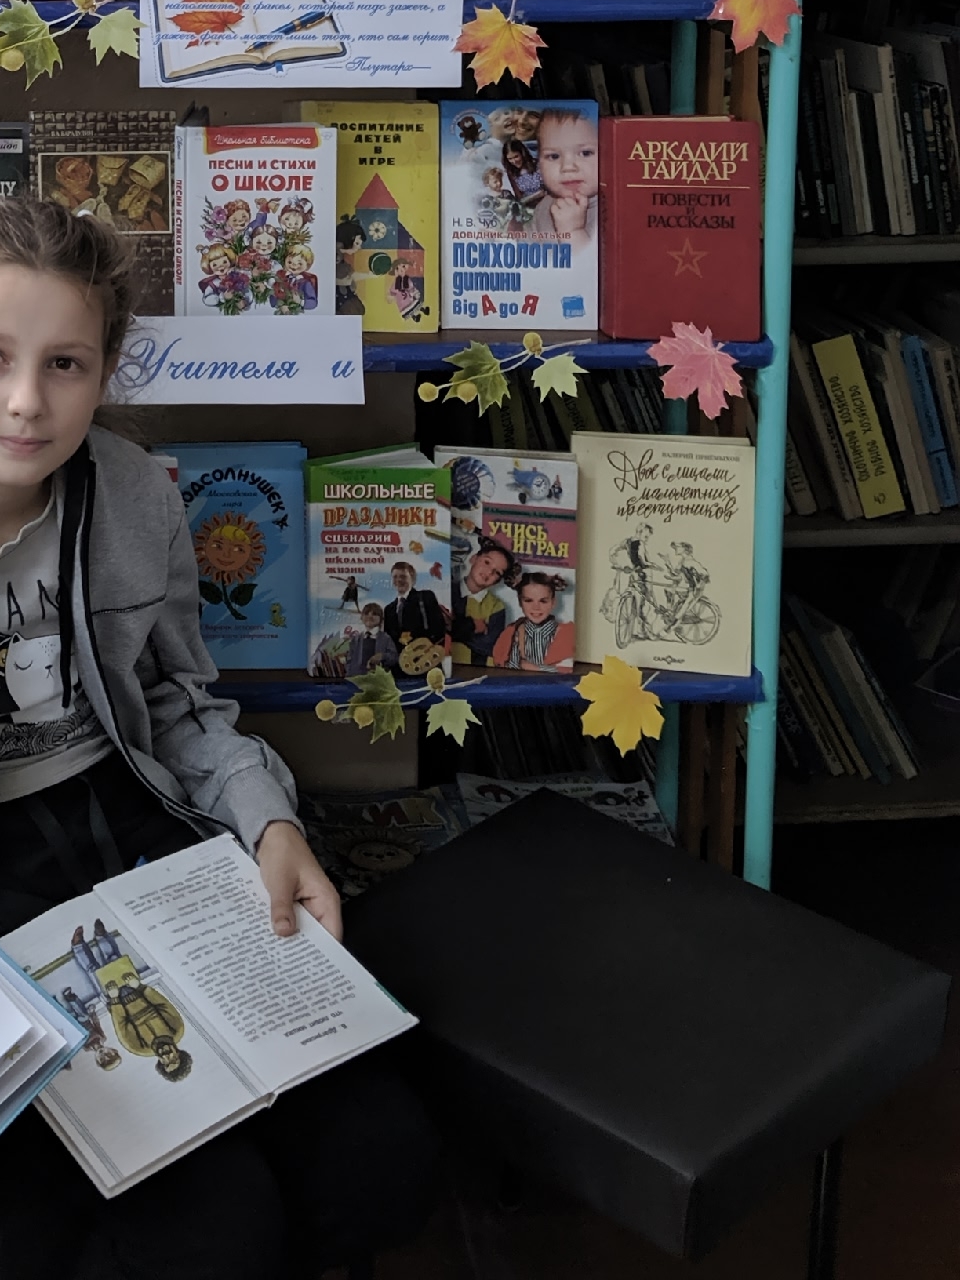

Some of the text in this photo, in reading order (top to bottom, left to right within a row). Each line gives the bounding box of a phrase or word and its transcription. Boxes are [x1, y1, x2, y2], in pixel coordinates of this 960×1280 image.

[241, 3, 250, 12] а
[298, 2, 354, 14] который
[356, 3, 387, 15] надо
[436, 3, 446, 12] а
[153, 33, 198, 45] зажечь
[200, 32, 238, 44] факел
[240, 33, 284, 42] может
[285, 33, 317, 42] лишь
[358, 33, 384, 42] кто
[386, 33, 410, 42] сам
[331, 122, 425, 133] ВОСПИТАНИЕ
[260, 133, 312, 146] библиотека
[353, 133, 402, 144] ДЕТЕЙ
[373, 146, 383, 155] В
[627, 140, 750, 163] АРКАДИЙ
[208, 159, 317, 171] ПЕСНИ И СТИХИ
[358, 156, 396, 166] ИГРЕ
[641, 160, 738, 185] ГАЙДАР
[211, 174, 314, 192] О ШКОЛЕ
[175, 179, 184, 208] ПЕСНИ
[651, 192, 731, 208] ПОВЕСТИ
[685, 206, 696, 216] И
[452, 217, 464, 228] Н.
[465, 217, 476, 228] В.
[646, 215, 736, 230] РАССКАЗЫ
[175, 218, 184, 246] СТИХИ
[452, 230, 572, 240] ДОВІДНИК ДЛЯ БАТЬКІВ
[452, 242, 572, 269] ПСИХОЛОГІЯ
[175, 257, 184, 286] ШКОЛЕ
[452, 271, 521, 297] дитини
[452, 294, 539, 319] Від А до Я
[114, 337, 356, 389] Учителя и
[607, 448, 660, 493] Двое
[182, 466, 286, 514] ОДСОЛНУШЕК
[324, 483, 435, 500] ШКОЛЬНЫЕ
[626, 483, 741, 505] малолетних
[322, 506, 438, 529] ПРАЗДНИКИ
[616, 498, 741, 523] преступников
[324, 533, 392, 544] СЦЕНАРИИ
[487, 521, 548, 541] УЧИСЬ
[325, 546, 404, 556] на все случаи
[512, 538, 570, 559] ИГРАЯ
[324, 554, 385, 565] школьной
[325, 566, 366, 574] жизни
